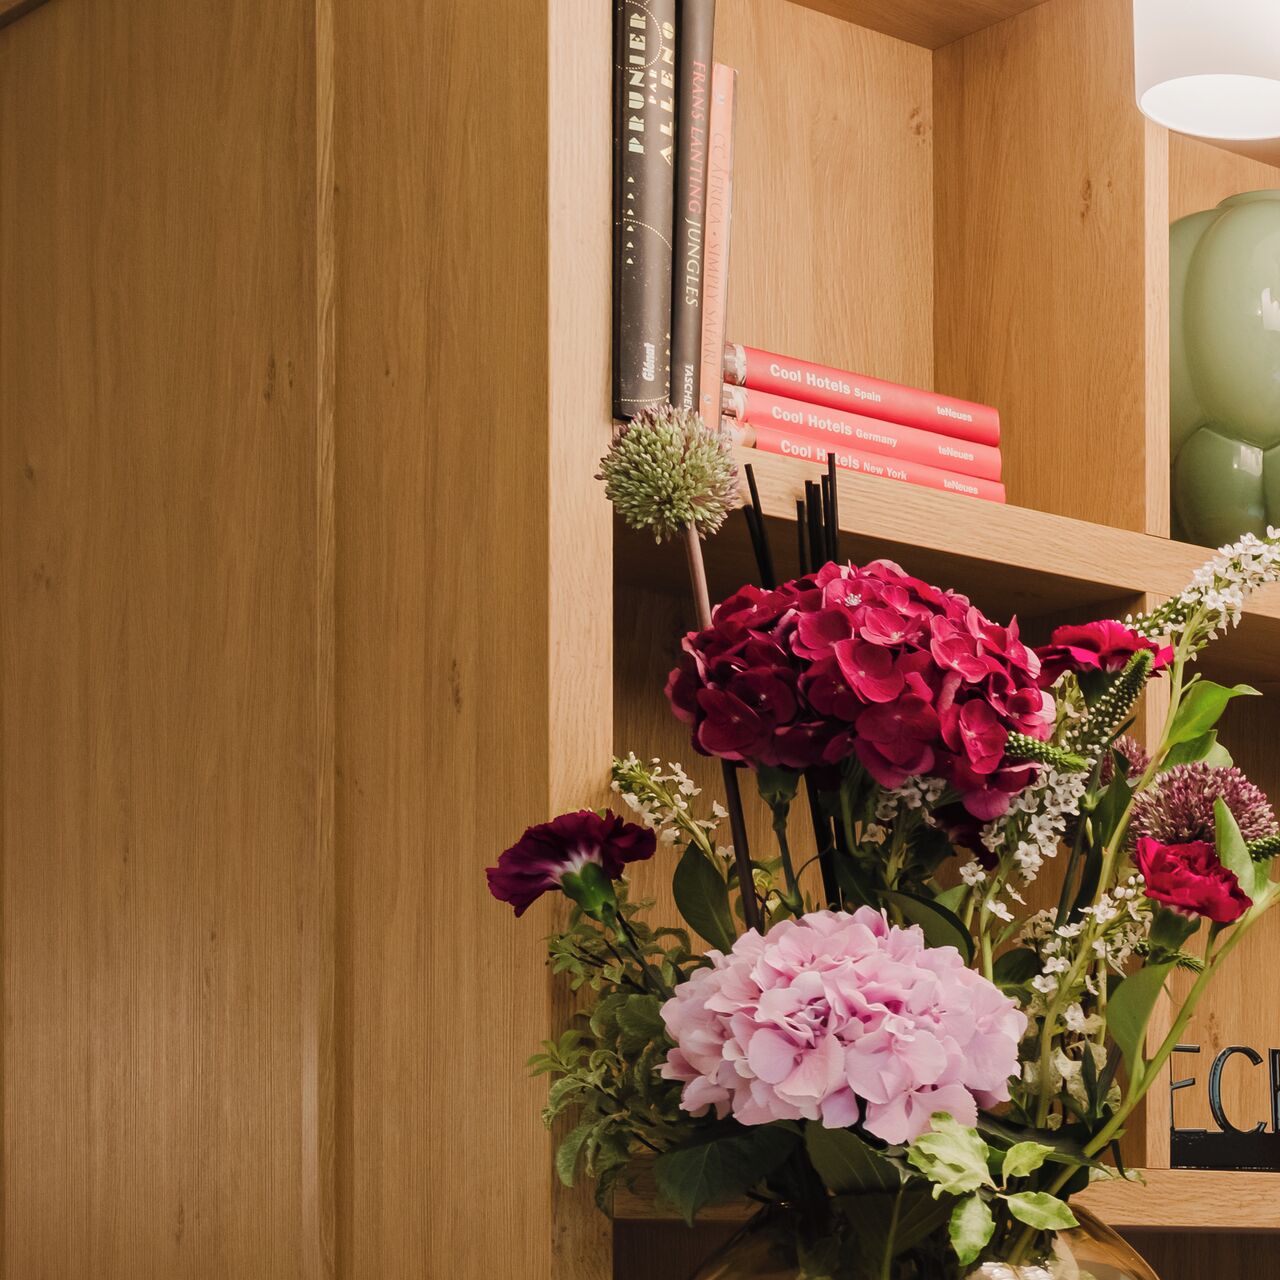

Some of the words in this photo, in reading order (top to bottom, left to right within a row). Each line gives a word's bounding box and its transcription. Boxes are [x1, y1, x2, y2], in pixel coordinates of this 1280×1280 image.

[628, 12, 646, 154] PRUNIER
[648, 69, 658, 105] PAR
[690, 61, 706, 120] FRANS
[688, 126, 704, 214] LANTING
[685, 217, 702, 308] JUNGLES
[770, 363, 801, 383] Cool
[806, 372, 851, 395] Hotels
[854, 387, 881, 402] Spain
[771, 406, 803, 425] Cool
[808, 414, 853, 436] Hotels
[855, 428, 898, 448] Germany
[937, 406, 973, 422] teNeues
[780, 440, 812, 459] Cool
[816, 447, 860, 470] Htels
[863, 462, 883, 475] New
[886, 467, 908, 481] York
[938, 446, 974, 462] teNeues
[943, 479, 979, 495] teNeues
